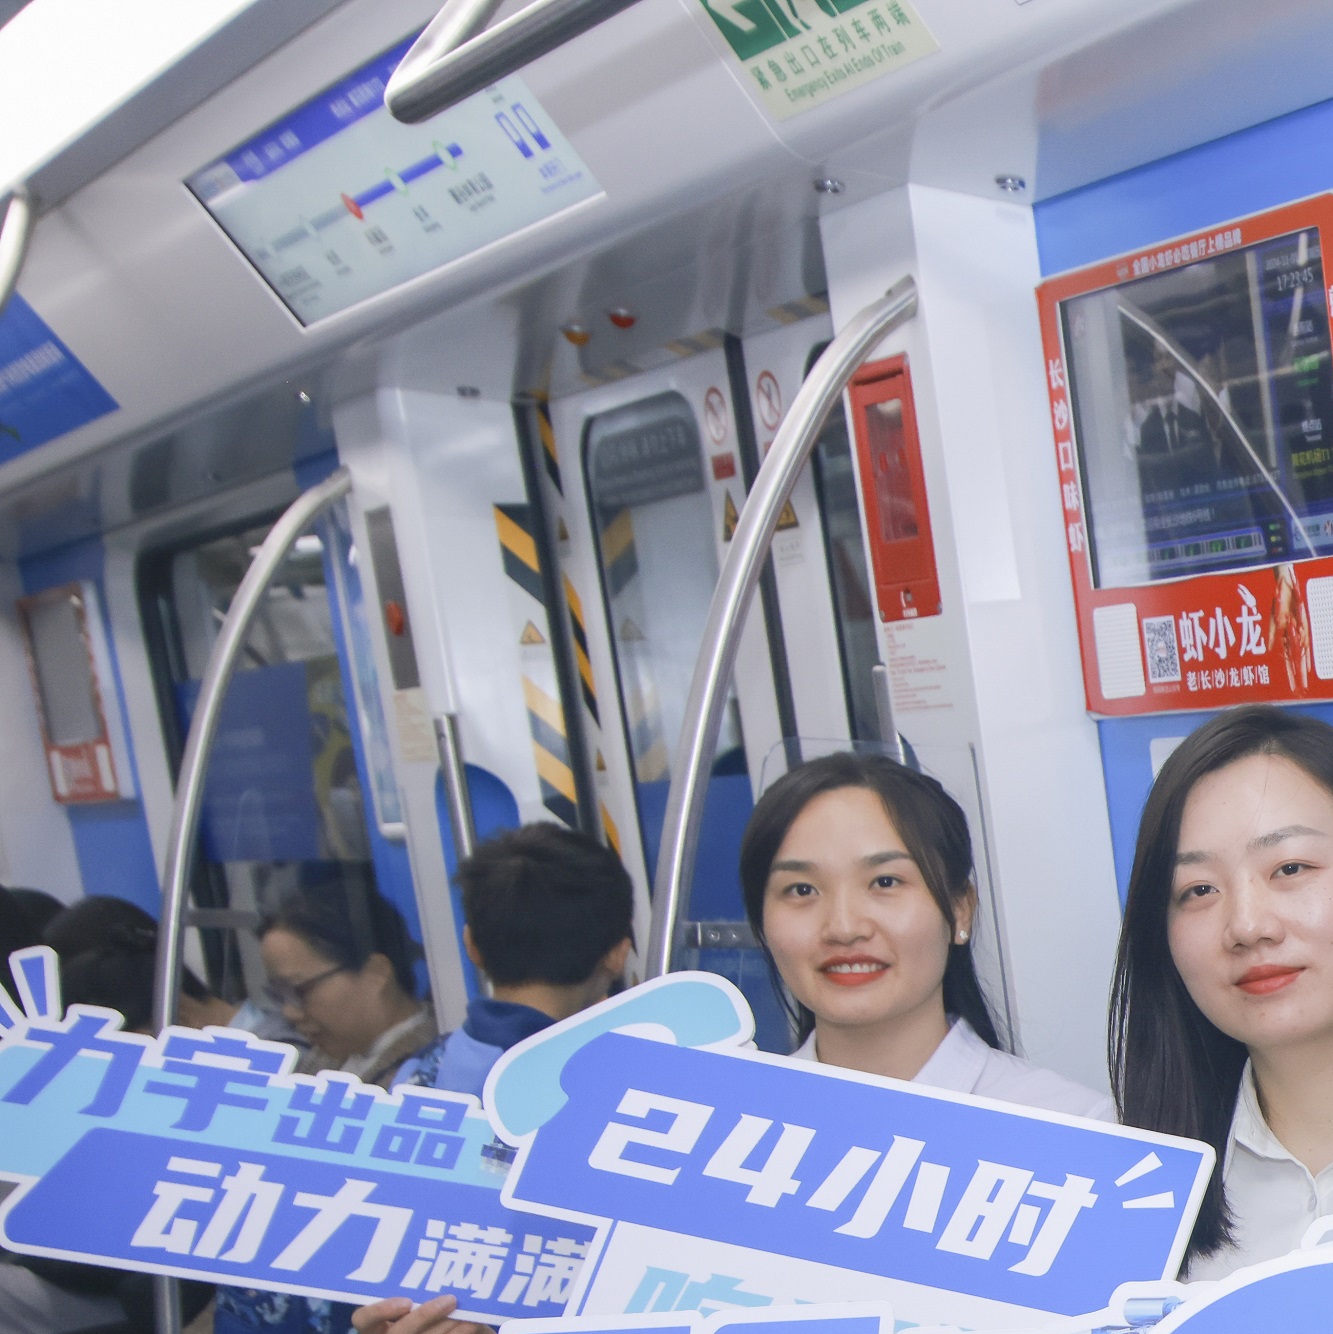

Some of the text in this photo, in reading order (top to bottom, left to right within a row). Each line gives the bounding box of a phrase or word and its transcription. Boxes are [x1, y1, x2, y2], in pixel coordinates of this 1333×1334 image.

[750, 0, 911, 91] 紧急出口在列车两端
[1047, 359, 1084, 553] 长沙口味虾
[1178, 594, 1267, 663] 虾小龙
[3, 1013, 470, 1170] 力宇出品
[130, 1156, 591, 1306] 动力满满
[587, 1087, 1099, 1277] 24小时
